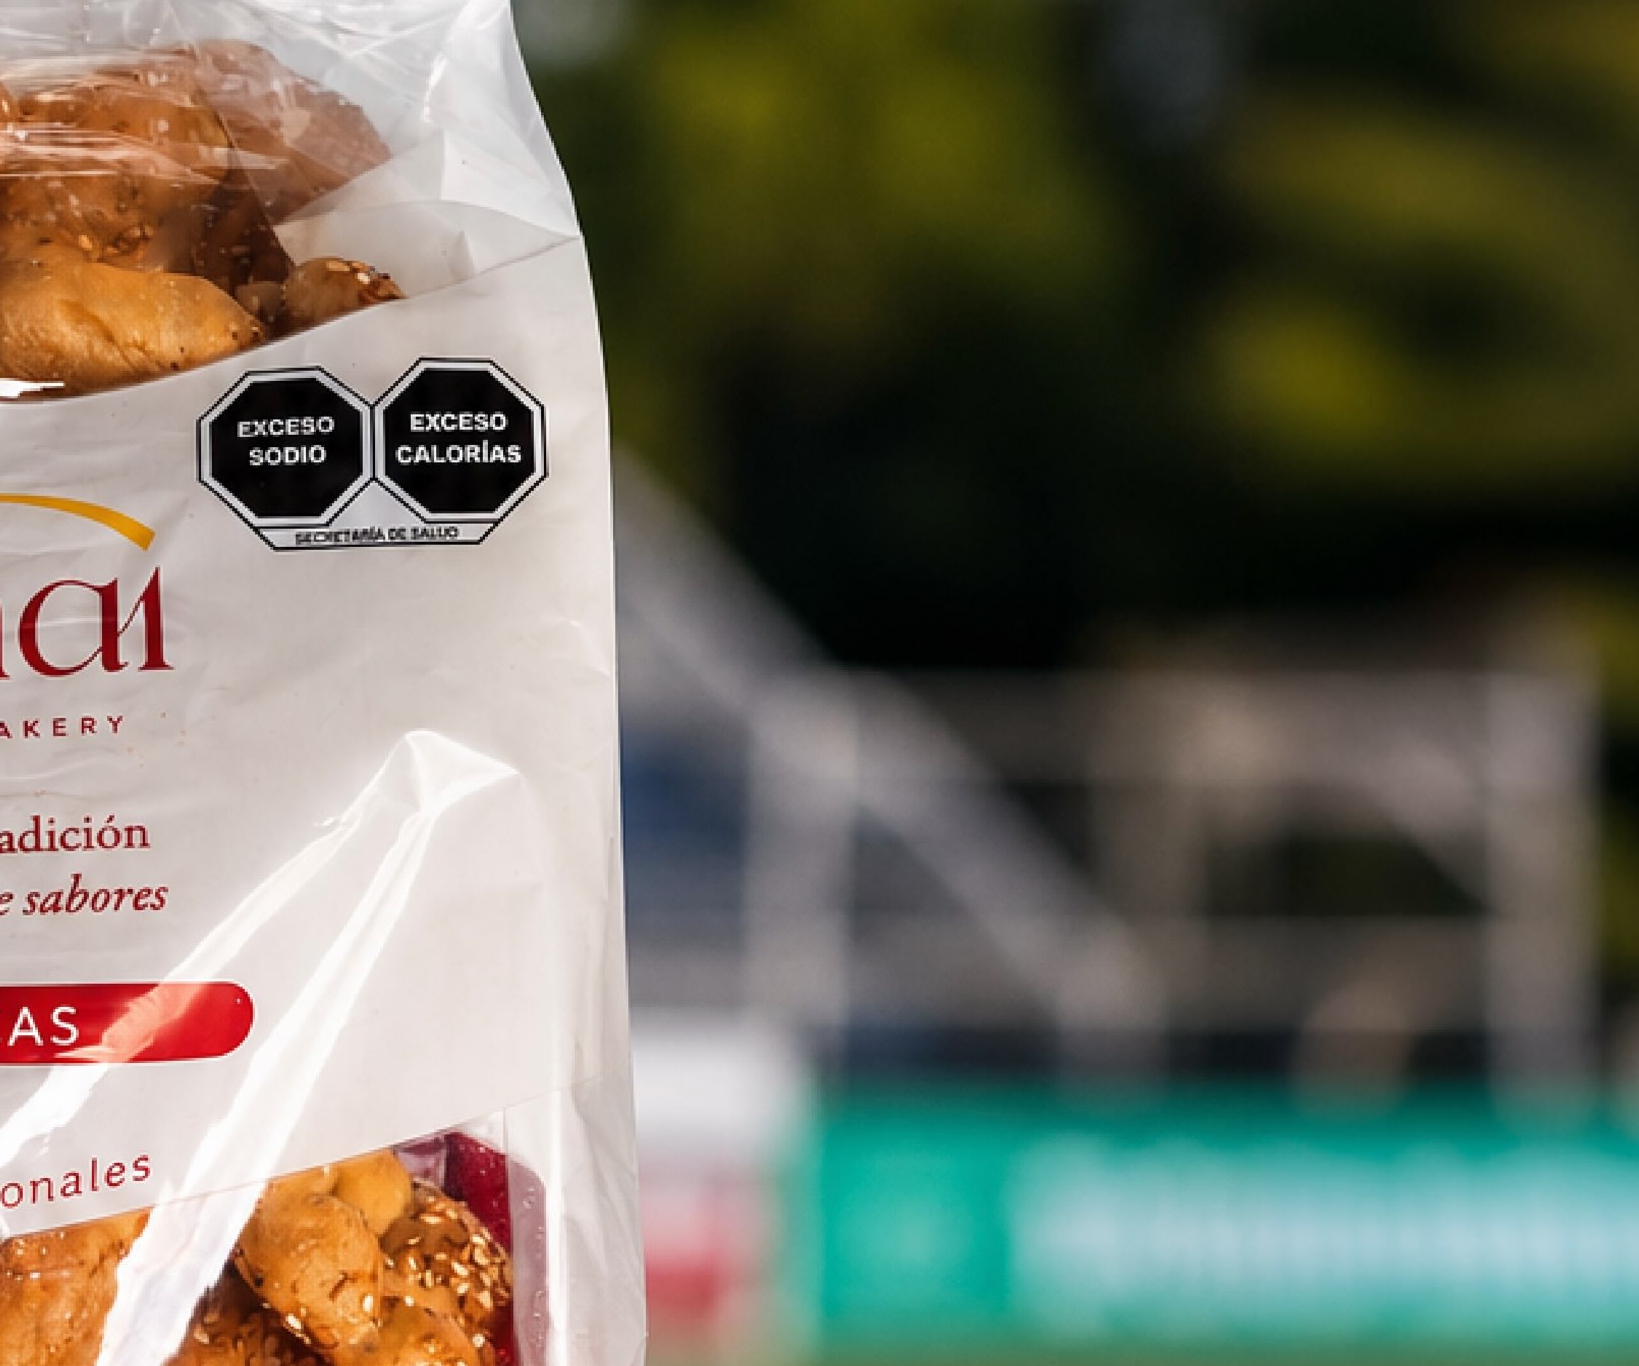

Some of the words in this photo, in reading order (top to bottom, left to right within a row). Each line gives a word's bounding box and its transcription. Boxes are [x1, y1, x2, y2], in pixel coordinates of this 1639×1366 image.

[238, 416, 335, 439] EXCESO
[410, 412, 508, 433] EXCESO
[249, 445, 327, 467] SODIO
[395, 439, 522, 464] CALORÍAS
[22, 873, 169, 915] sabores
